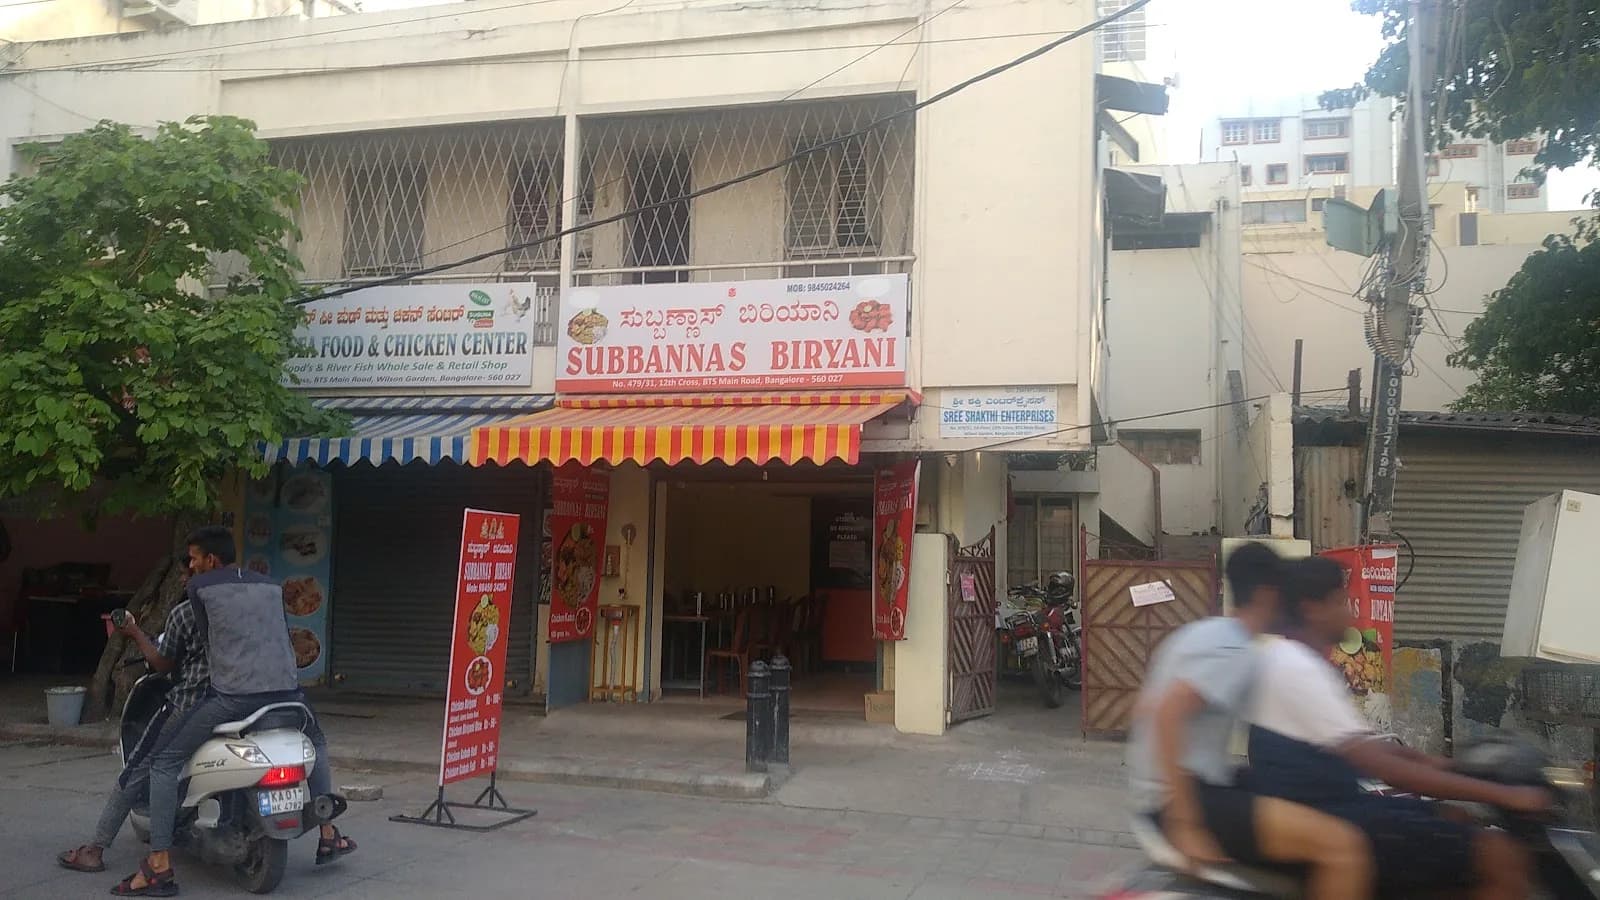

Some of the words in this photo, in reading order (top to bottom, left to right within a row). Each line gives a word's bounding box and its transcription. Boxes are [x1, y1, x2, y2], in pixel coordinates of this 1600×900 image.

[807, 282, 850, 292] 9845024264
[739, 299, 840, 324] ಬಿರಿಯಾನಿ
[320, 335, 364, 358] FOOD
[368, 334, 380, 358] &
[384, 332, 458, 358] CHICKEN
[461, 331, 528, 355] CENTER
[566, 342, 746, 376] SUBBANNAS
[771, 337, 896, 370] BIRYANI
[326, 362, 351, 372] River
[354, 361, 374, 372] Fish
[377, 360, 409, 371] Whole
[412, 361, 434, 370] Sale
[437, 361, 444, 370] &
[448, 359, 477, 371] Retail
[481, 360, 508, 372] Shop
[375, 374, 401, 383] Wilson
[403, 374, 437, 384] Garden,
[487, 374, 503, 382] 560
[612, 379, 626, 389] No.
[659, 379, 677, 388] 12th
[677, 378, 701, 388] Cross,
[702, 378, 717, 386] BTS
[719, 377, 739, 386] Main
[741, 376, 763, 386] Road,
[764, 375, 804, 387] Bangalore
[811, 375, 826, 384] 560
[827, 374, 844, 384] 027
[943, 410, 963, 423] SREE
[965, 410, 998, 422] SHAKTHI
[1001, 409, 1055, 423] ENTERPRISES
